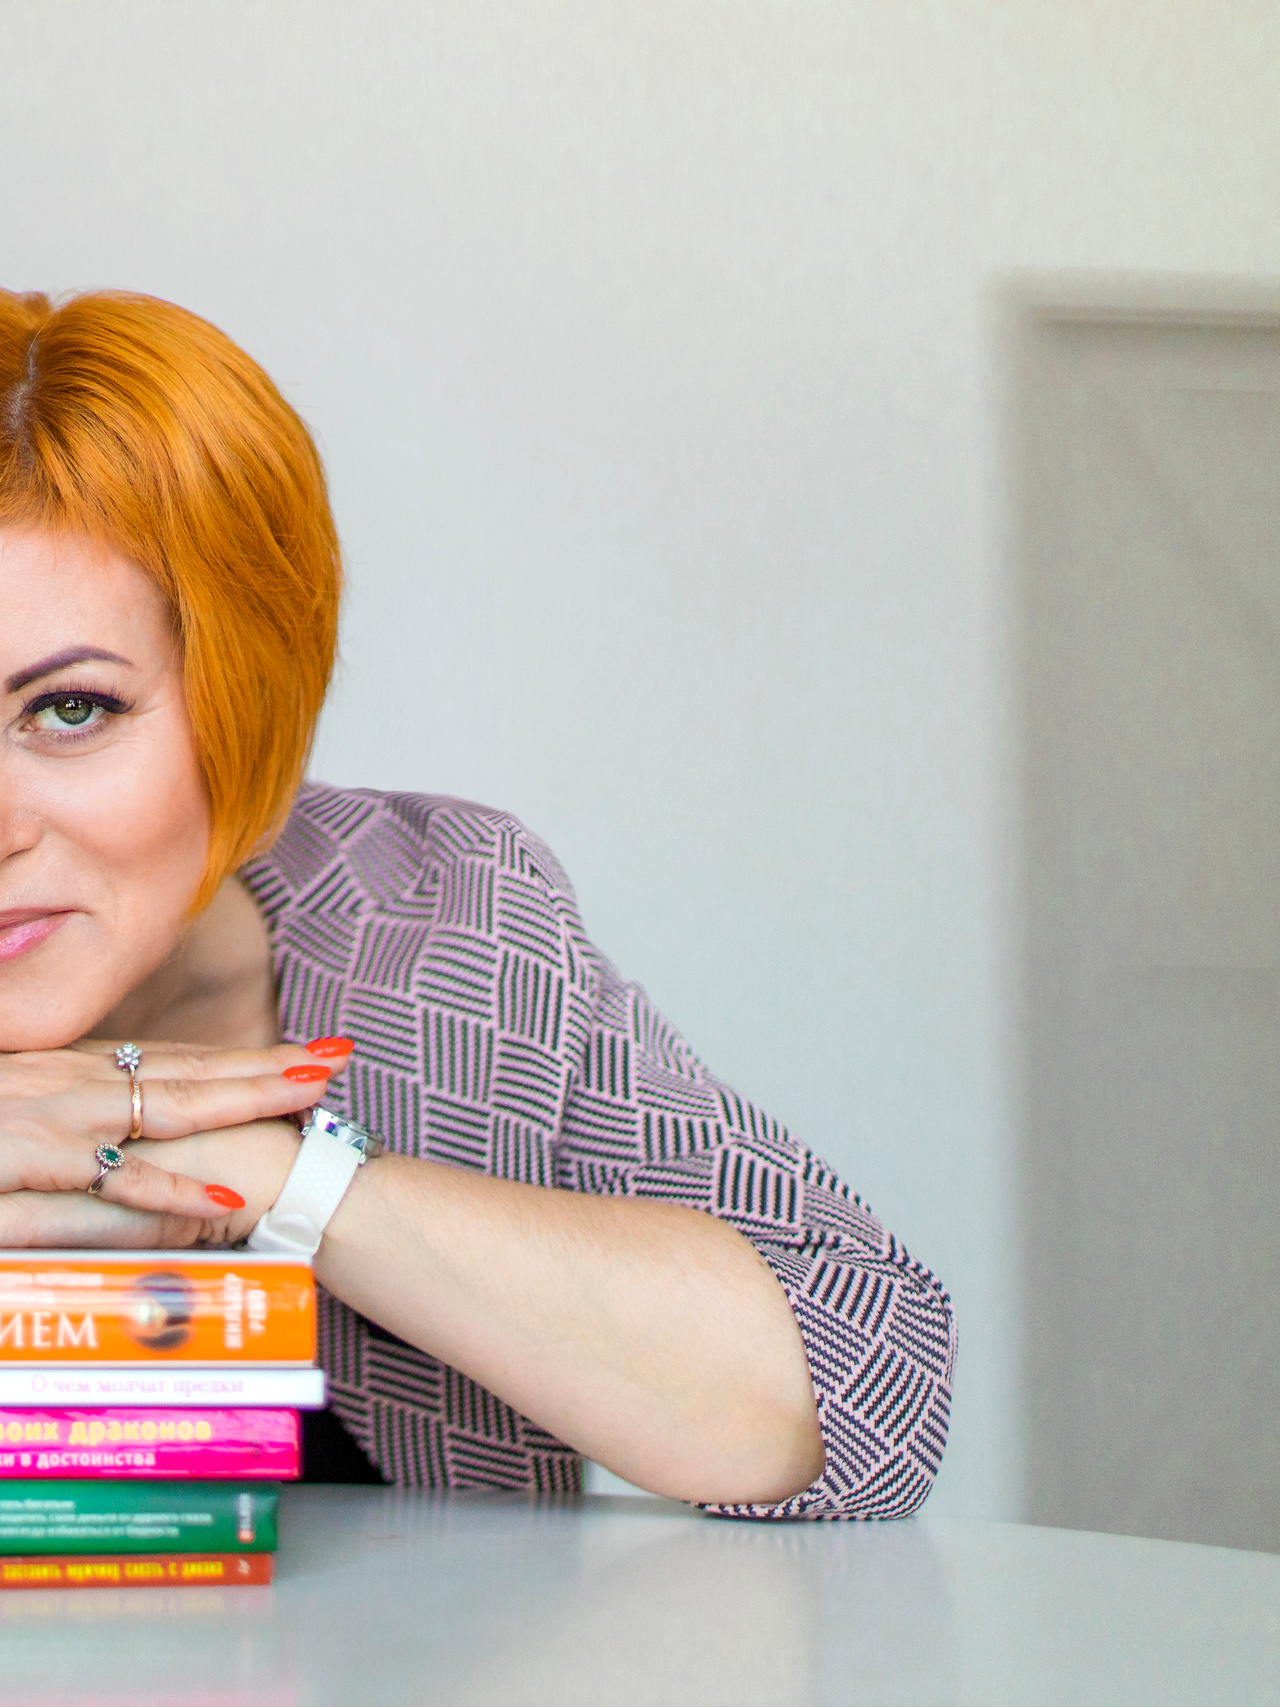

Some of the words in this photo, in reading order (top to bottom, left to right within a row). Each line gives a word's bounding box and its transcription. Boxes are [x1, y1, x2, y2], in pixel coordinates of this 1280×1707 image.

[31, 1375, 47, 1393] О
[54, 1378, 90, 1393] чем
[97, 1378, 166, 1394] молчат
[173, 1378, 244, 1396] предки
[68, 1420, 212, 1446] драконов
[20, 1452, 32, 1467] в
[37, 1452, 156, 1469] достоинства
